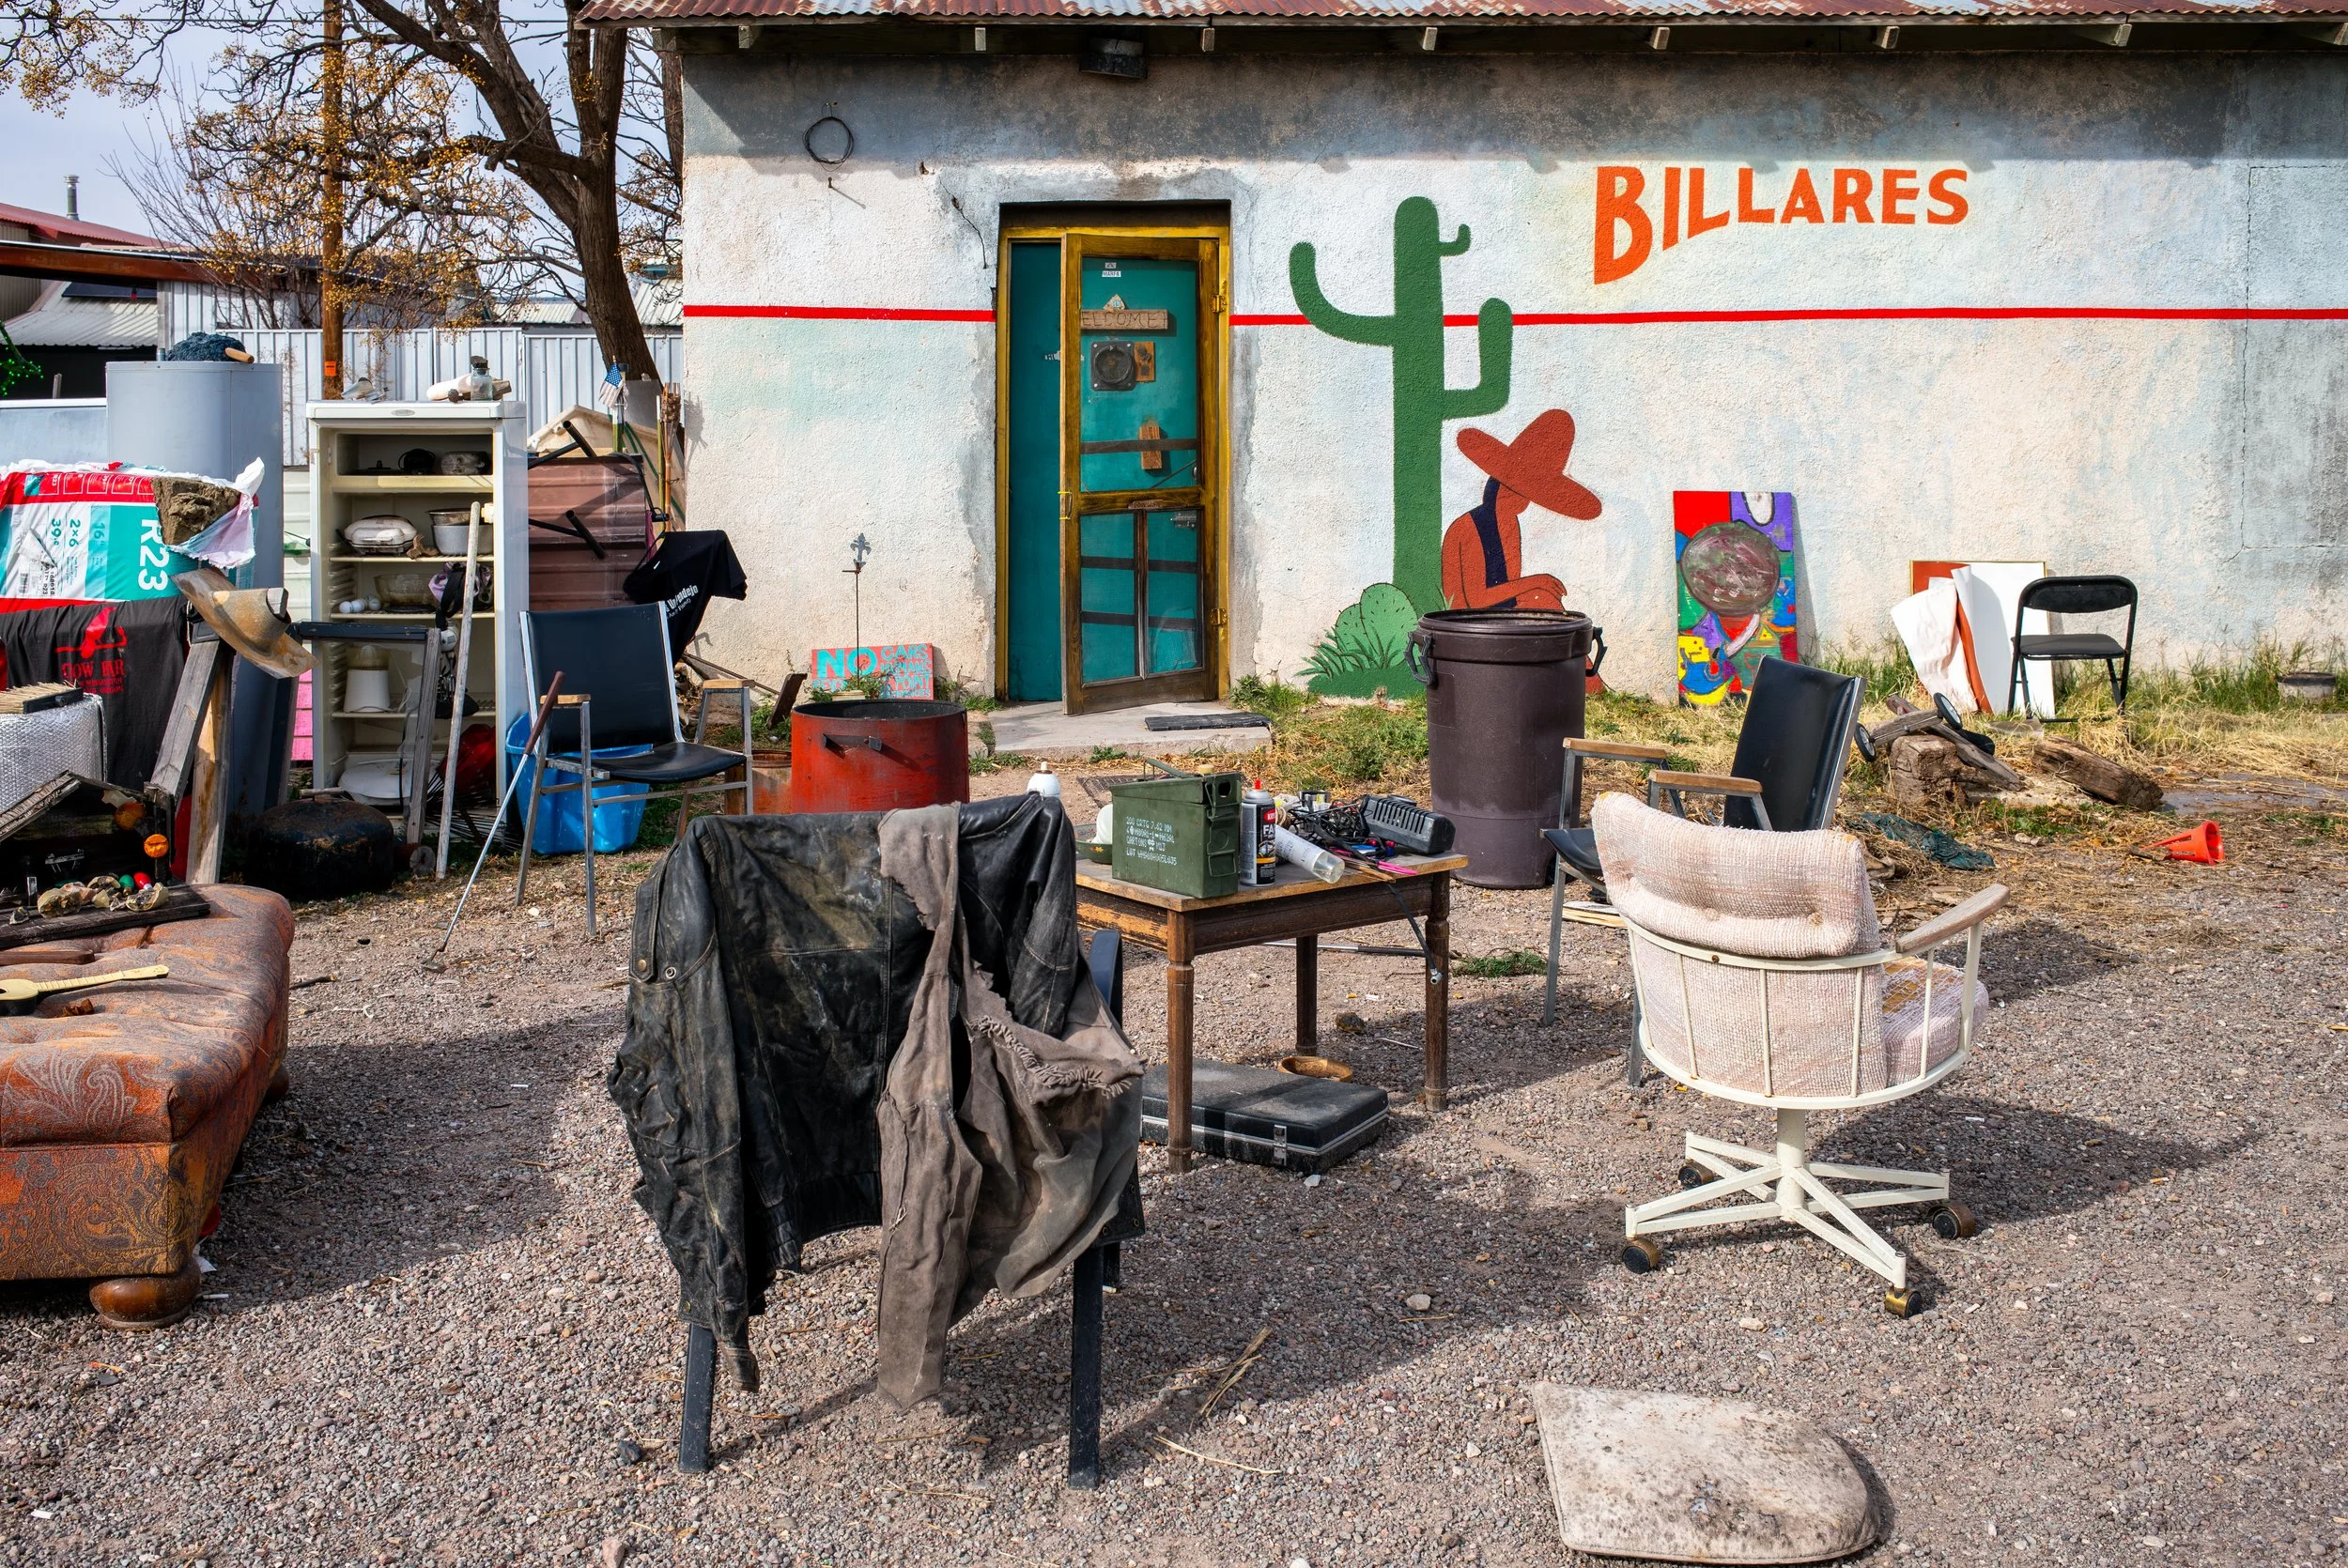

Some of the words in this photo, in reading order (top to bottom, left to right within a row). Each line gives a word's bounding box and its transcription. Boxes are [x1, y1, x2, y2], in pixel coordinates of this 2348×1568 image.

[1594, 165, 1970, 284] BILLARES
[138, 519, 170, 592] R23
[816, 648, 877, 678] NO
[881, 644, 929, 661] CARS
[895, 673, 932, 690] POINT
